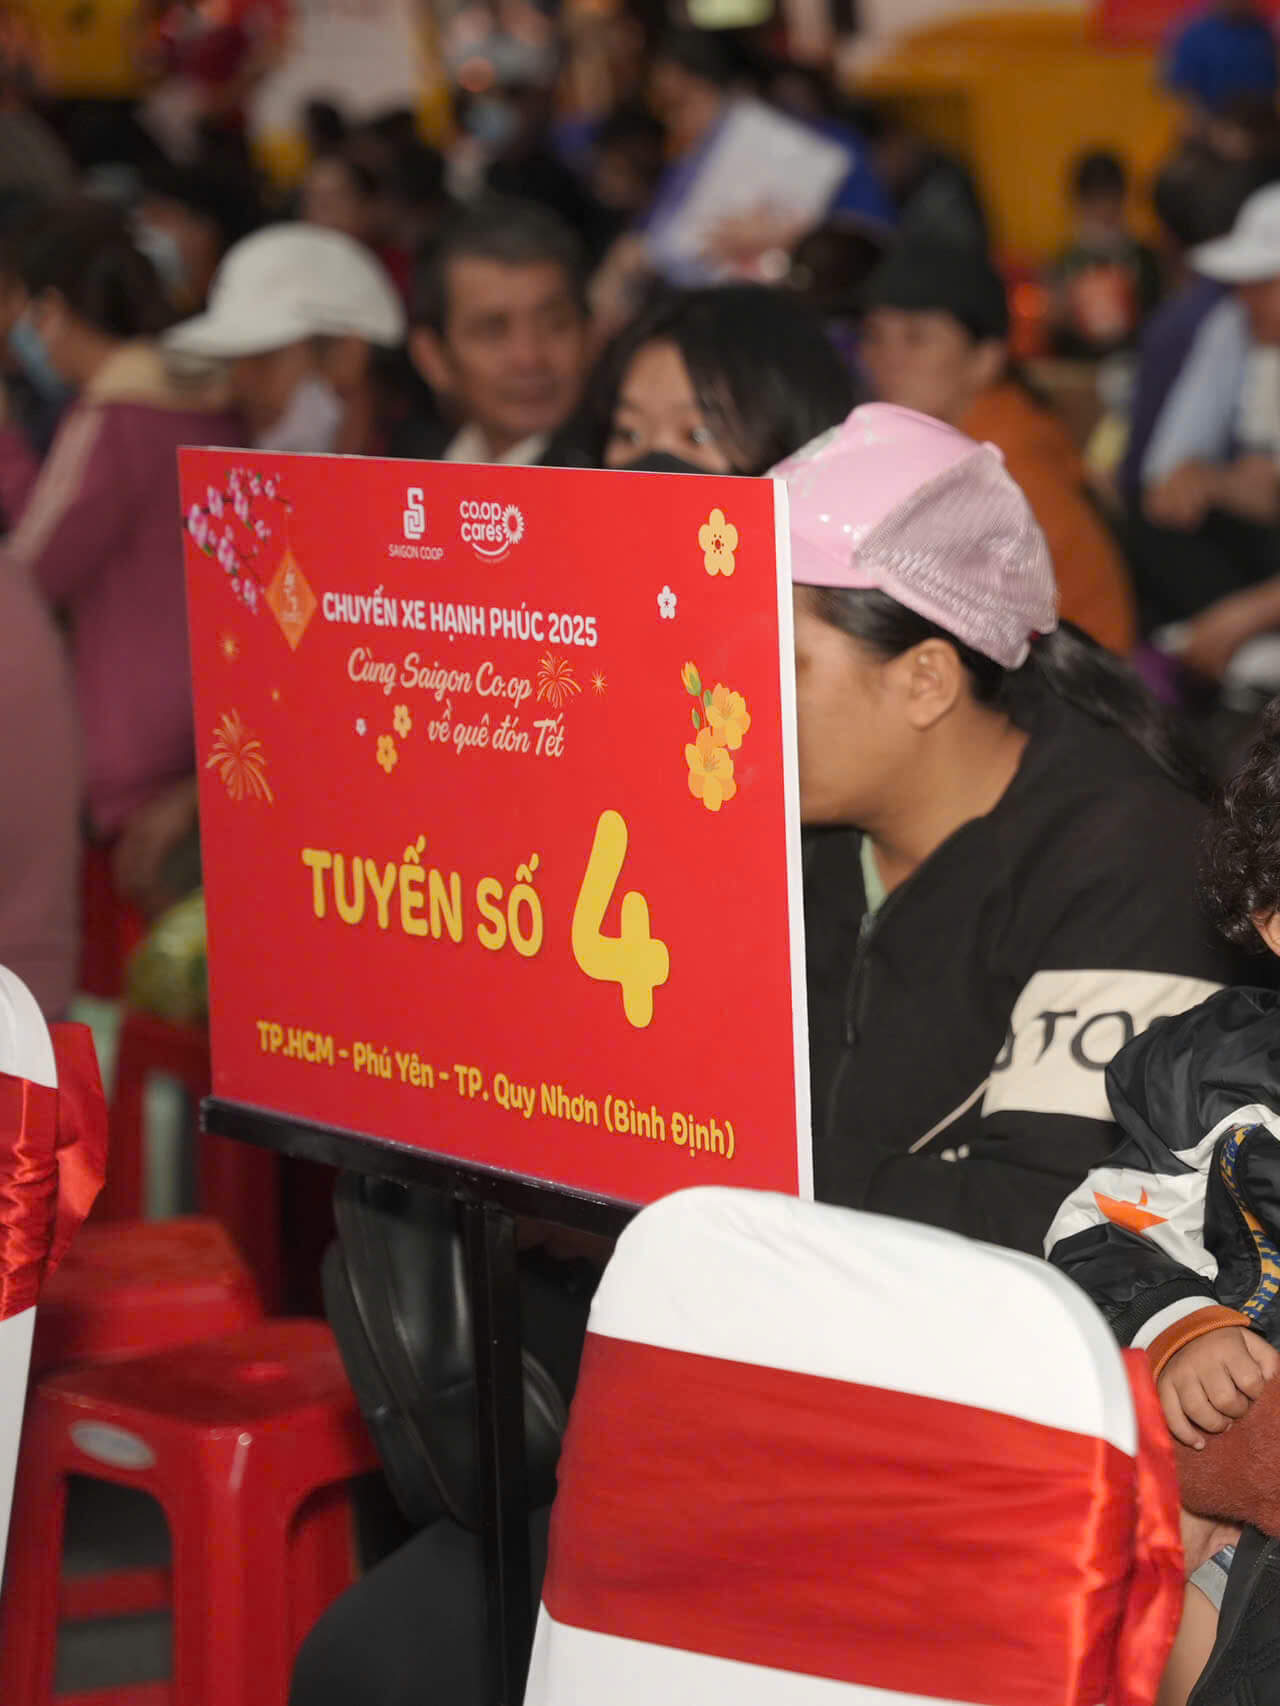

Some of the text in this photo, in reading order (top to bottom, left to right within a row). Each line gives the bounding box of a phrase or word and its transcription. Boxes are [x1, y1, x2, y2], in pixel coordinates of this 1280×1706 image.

[388, 544, 419, 559] SAIGON
[460, 522, 503, 542] cares
[322, 584, 598, 647] CHUYẾN XE HẠNH PHÚC 2025
[347, 647, 532, 709] Cùng Saigon Co.op
[427, 699, 565, 757] về quê đón Tết
[302, 835, 543, 957] TUYẾN SỐ
[571, 810, 670, 1028] 4
[256, 1020, 735, 1159] TP.HCM - Phú Yên - TP. Quy Nhơn (Bình Định)
